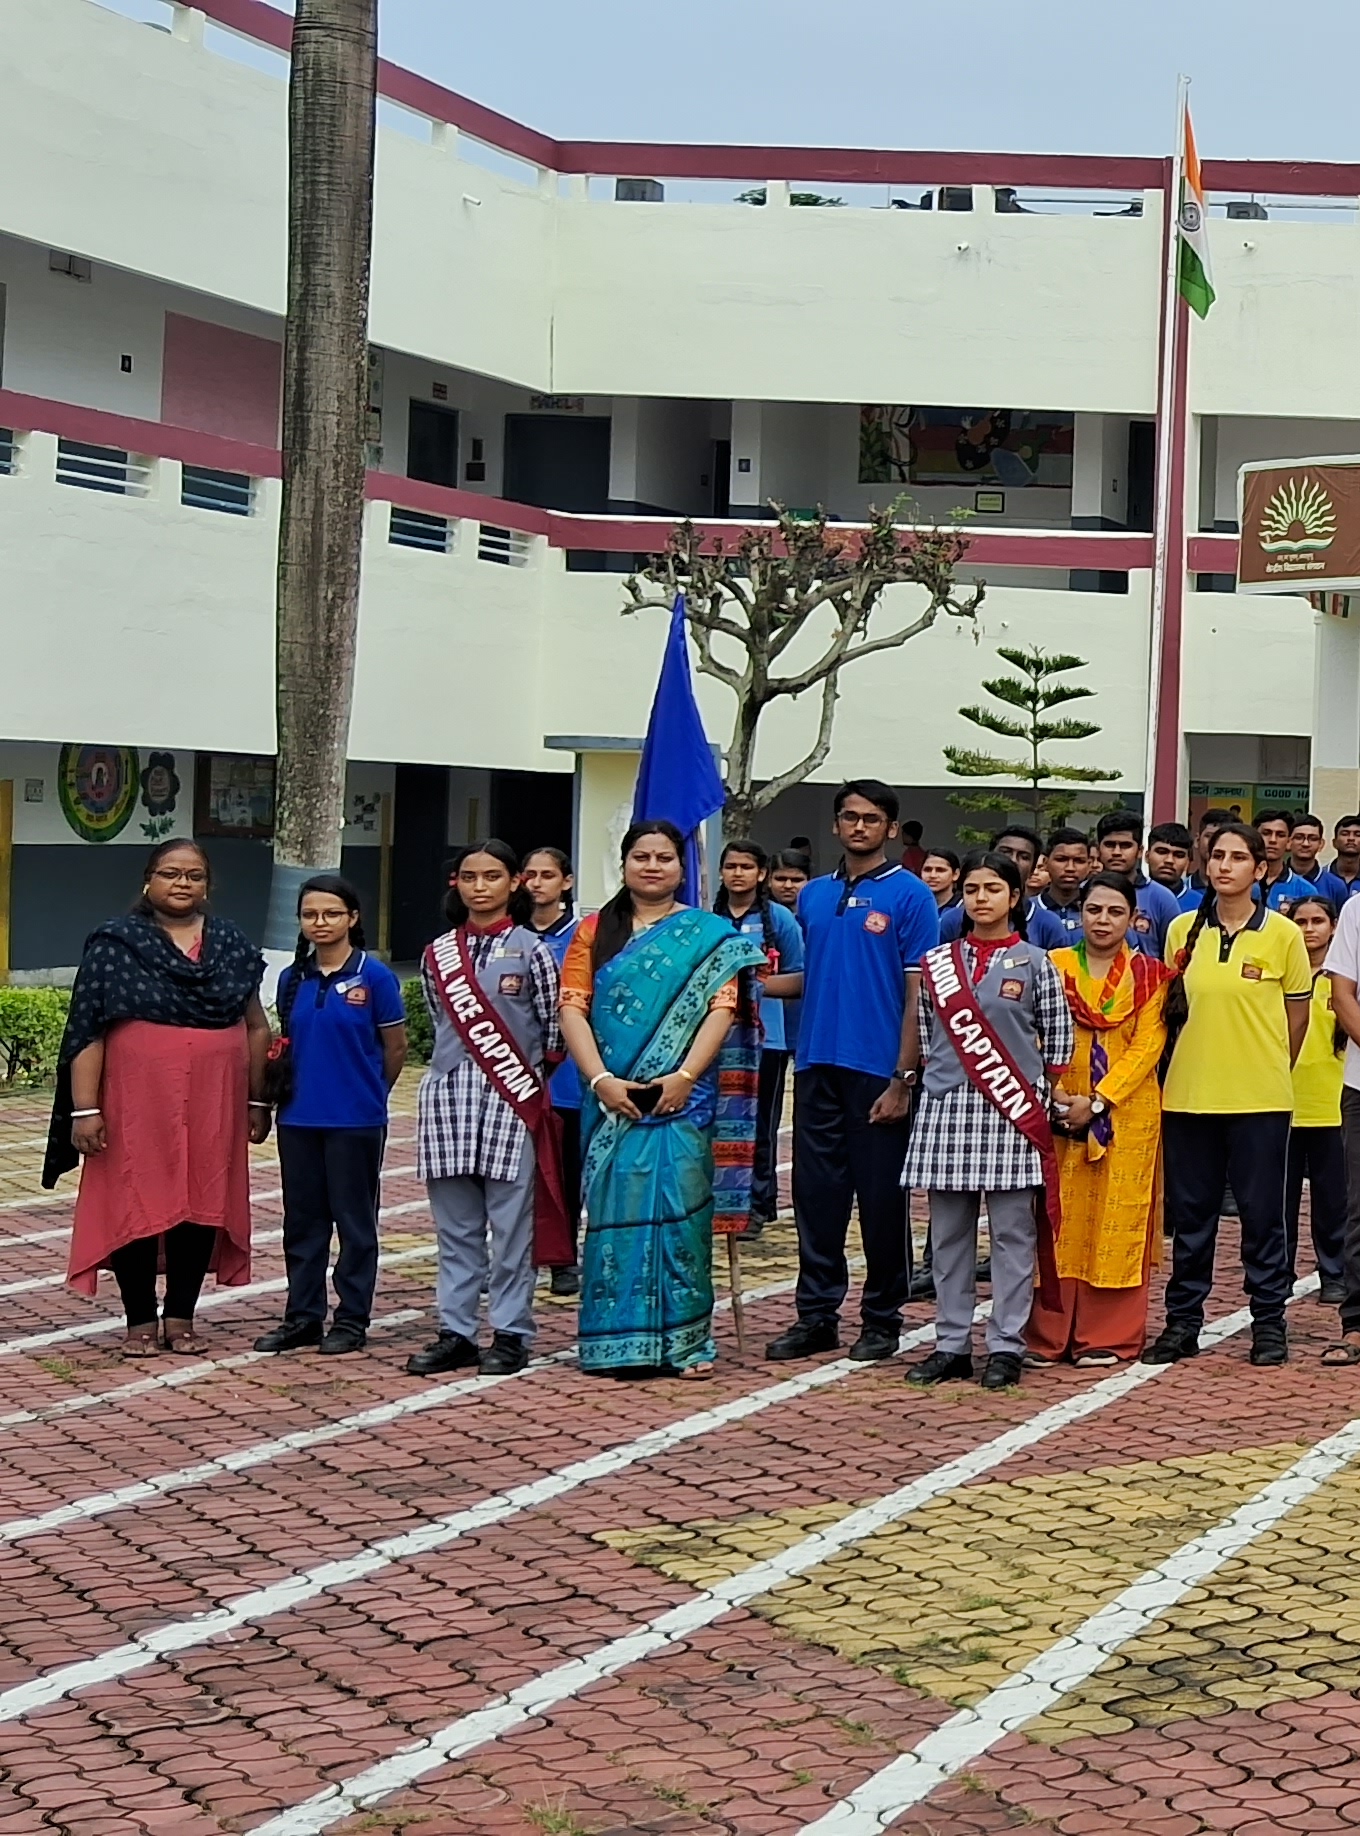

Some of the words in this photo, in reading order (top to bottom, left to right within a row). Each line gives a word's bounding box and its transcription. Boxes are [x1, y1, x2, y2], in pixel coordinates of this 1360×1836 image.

[1264, 789, 1291, 798] GOOD
[445, 975, 484, 1024] VICE
[468, 1020, 540, 1103] CAPTAIN
[949, 1008, 1032, 1121] CAPTAIN
